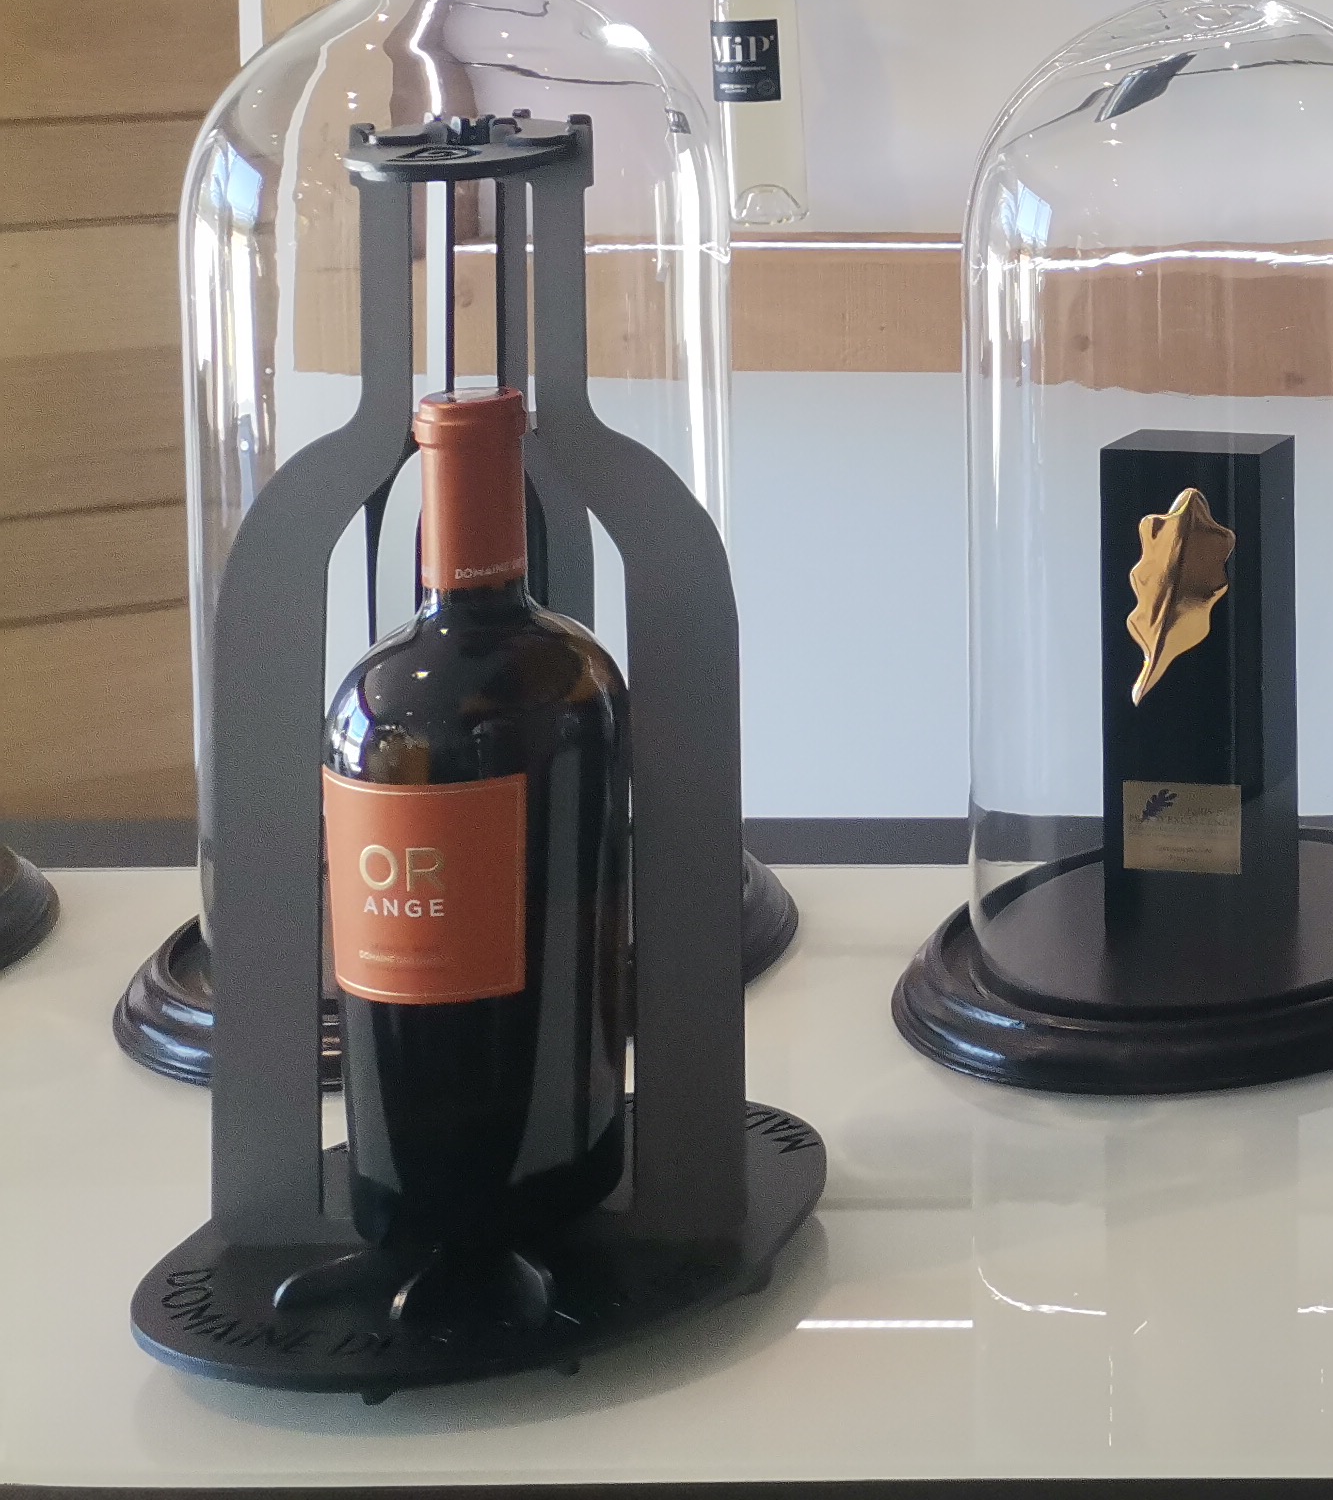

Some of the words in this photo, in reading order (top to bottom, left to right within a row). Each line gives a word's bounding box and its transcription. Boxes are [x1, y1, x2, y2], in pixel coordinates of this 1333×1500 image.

[712, 35, 770, 63] MiP
[359, 844, 446, 892] OR
[363, 896, 445, 918] ANGE
